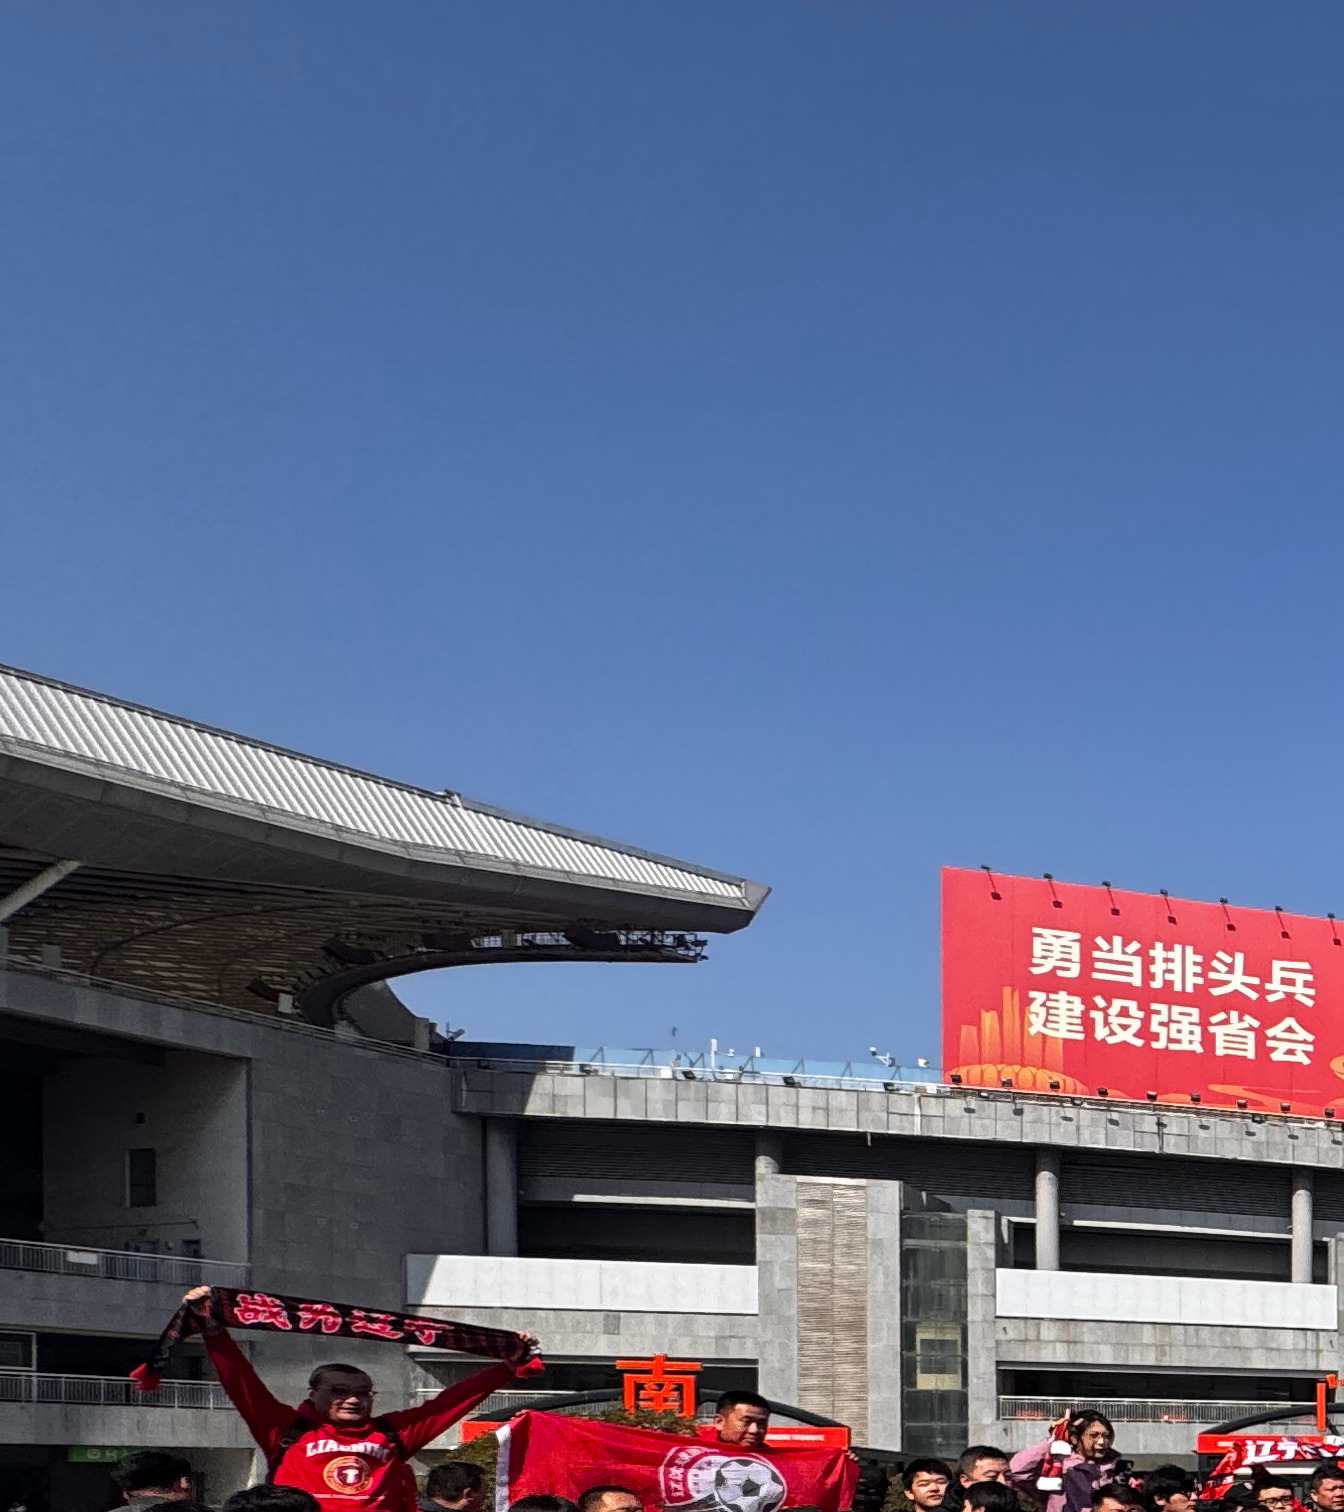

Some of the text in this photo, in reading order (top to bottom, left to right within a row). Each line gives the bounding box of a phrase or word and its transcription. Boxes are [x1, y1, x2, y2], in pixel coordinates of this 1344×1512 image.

[1029, 927, 1316, 1007] 勇当排头兵
[1028, 989, 1316, 1066] 建设强省会
[616, 1352, 703, 1418] 南
[1241, 1438, 1299, 1465] 辽宁
